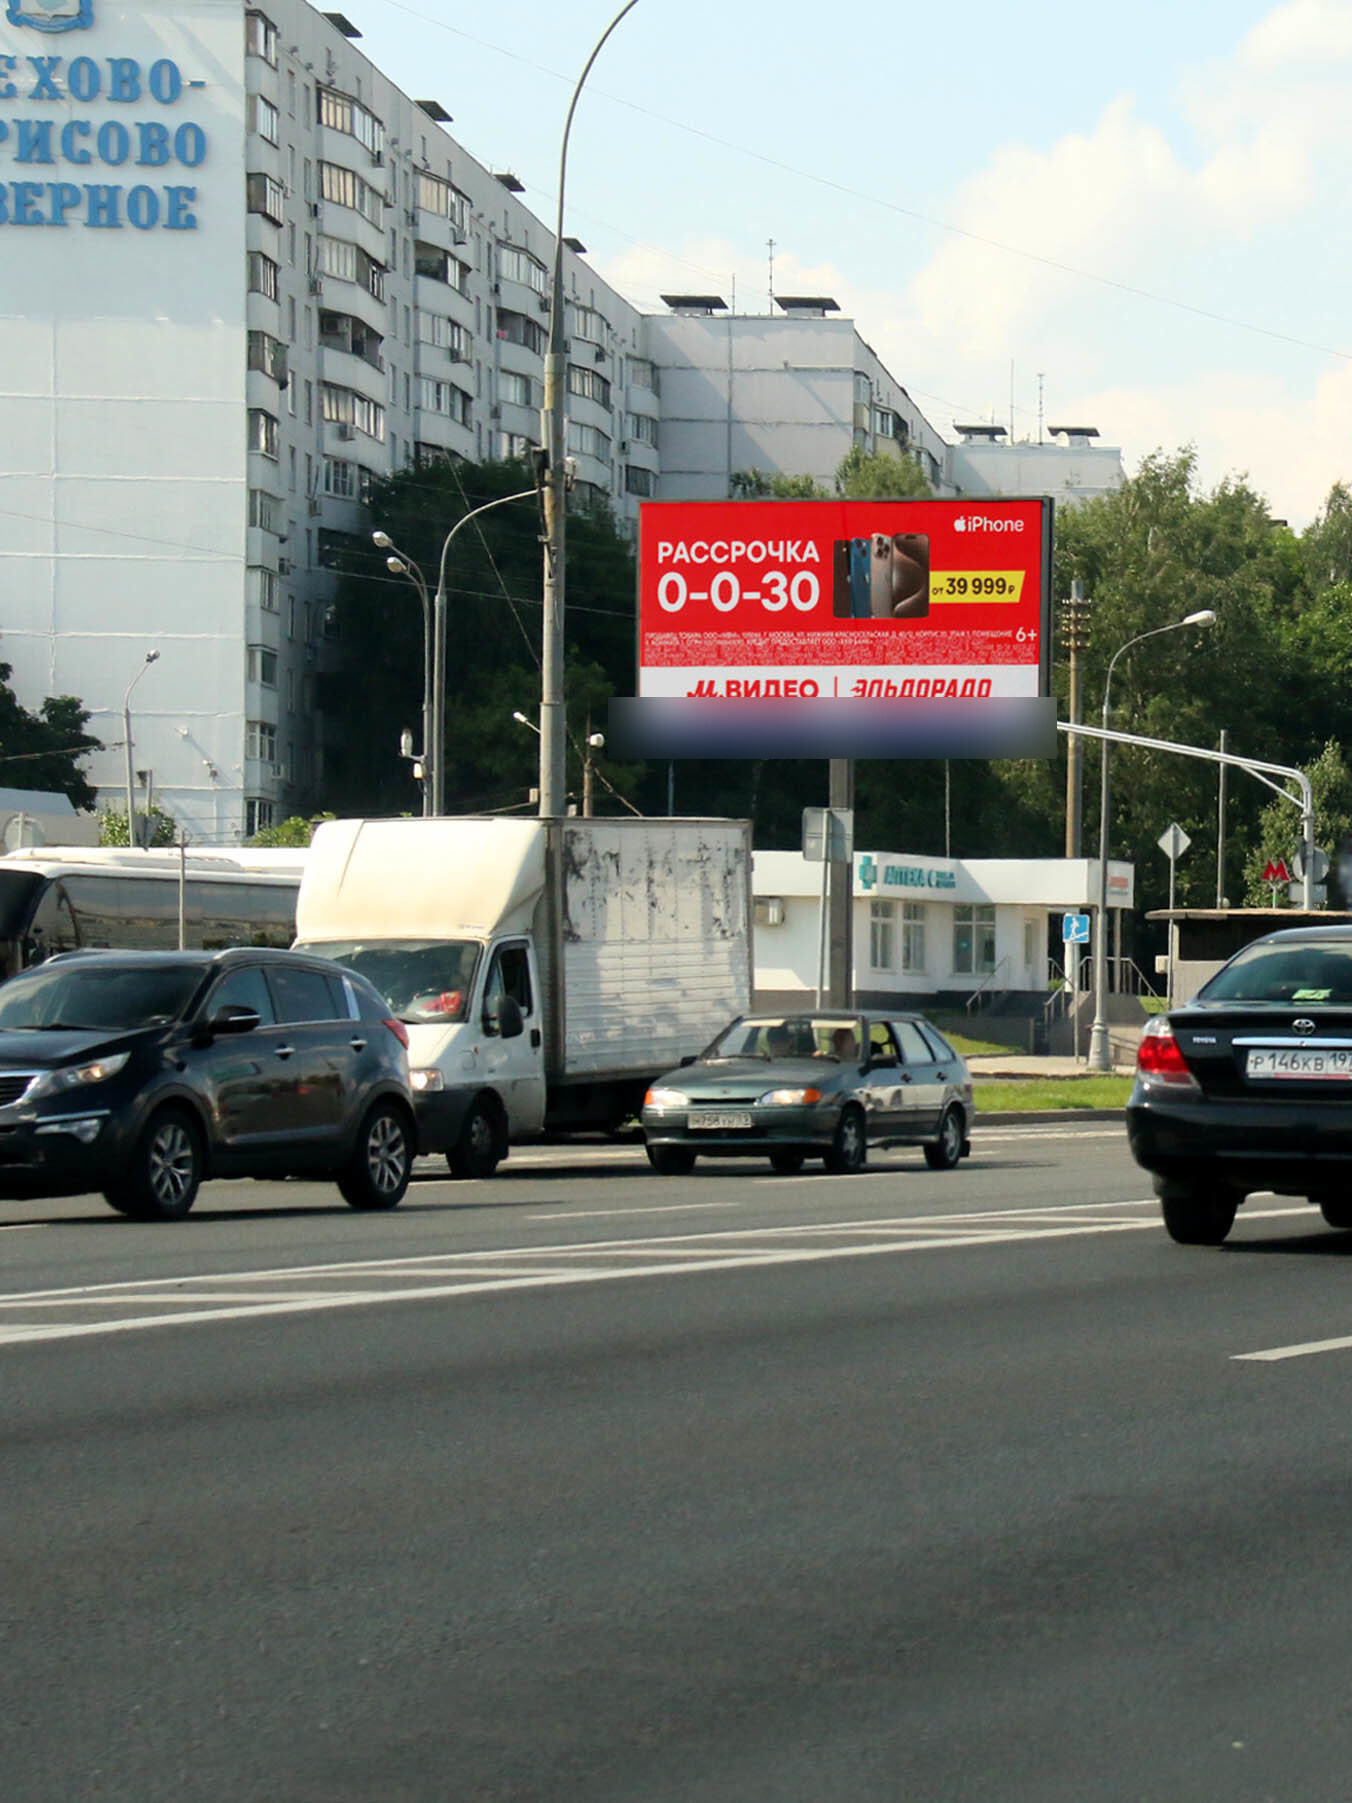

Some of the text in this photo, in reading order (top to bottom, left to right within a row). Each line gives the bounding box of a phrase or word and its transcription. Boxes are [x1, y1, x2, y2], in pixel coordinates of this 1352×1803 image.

[0, 118, 206, 167] ИСОВО
[0, 181, 198, 230] ЕРНОЕ
[968, 516, 1024, 532] iPhone
[657, 540, 820, 564] РАССРОЧКА
[657, 570, 820, 613] 0-0-30
[1015, 626, 1037, 642] 6+
[849, 678, 993, 698] ЭЛЬДОРАДО
